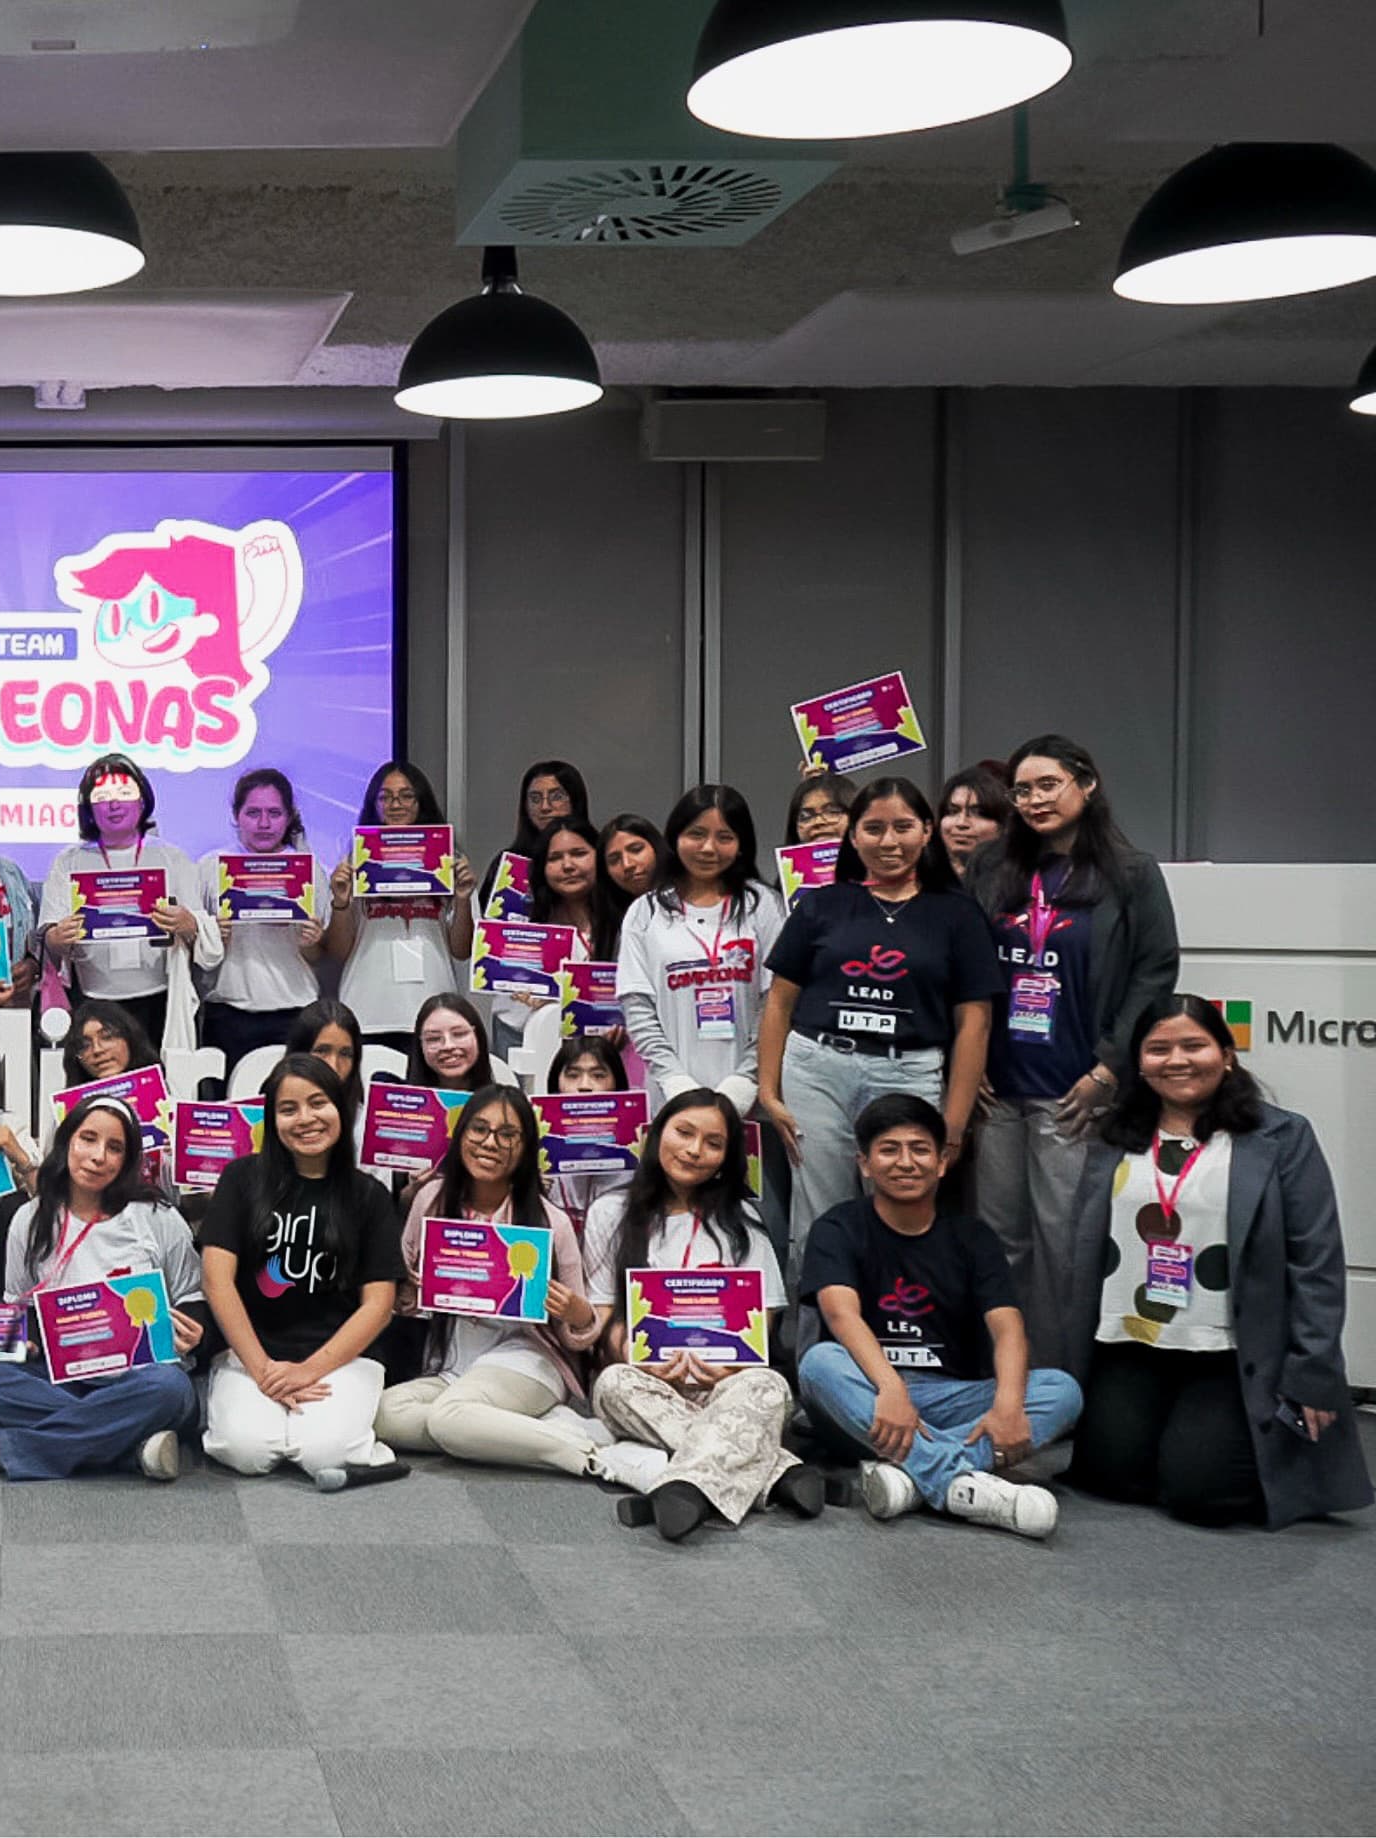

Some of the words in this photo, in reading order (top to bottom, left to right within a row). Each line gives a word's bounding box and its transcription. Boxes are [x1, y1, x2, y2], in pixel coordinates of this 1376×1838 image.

[847, 984, 895, 1001] LEAD
[841, 1013, 893, 1031] UTP
[1267, 1010, 1376, 1049] Micro
